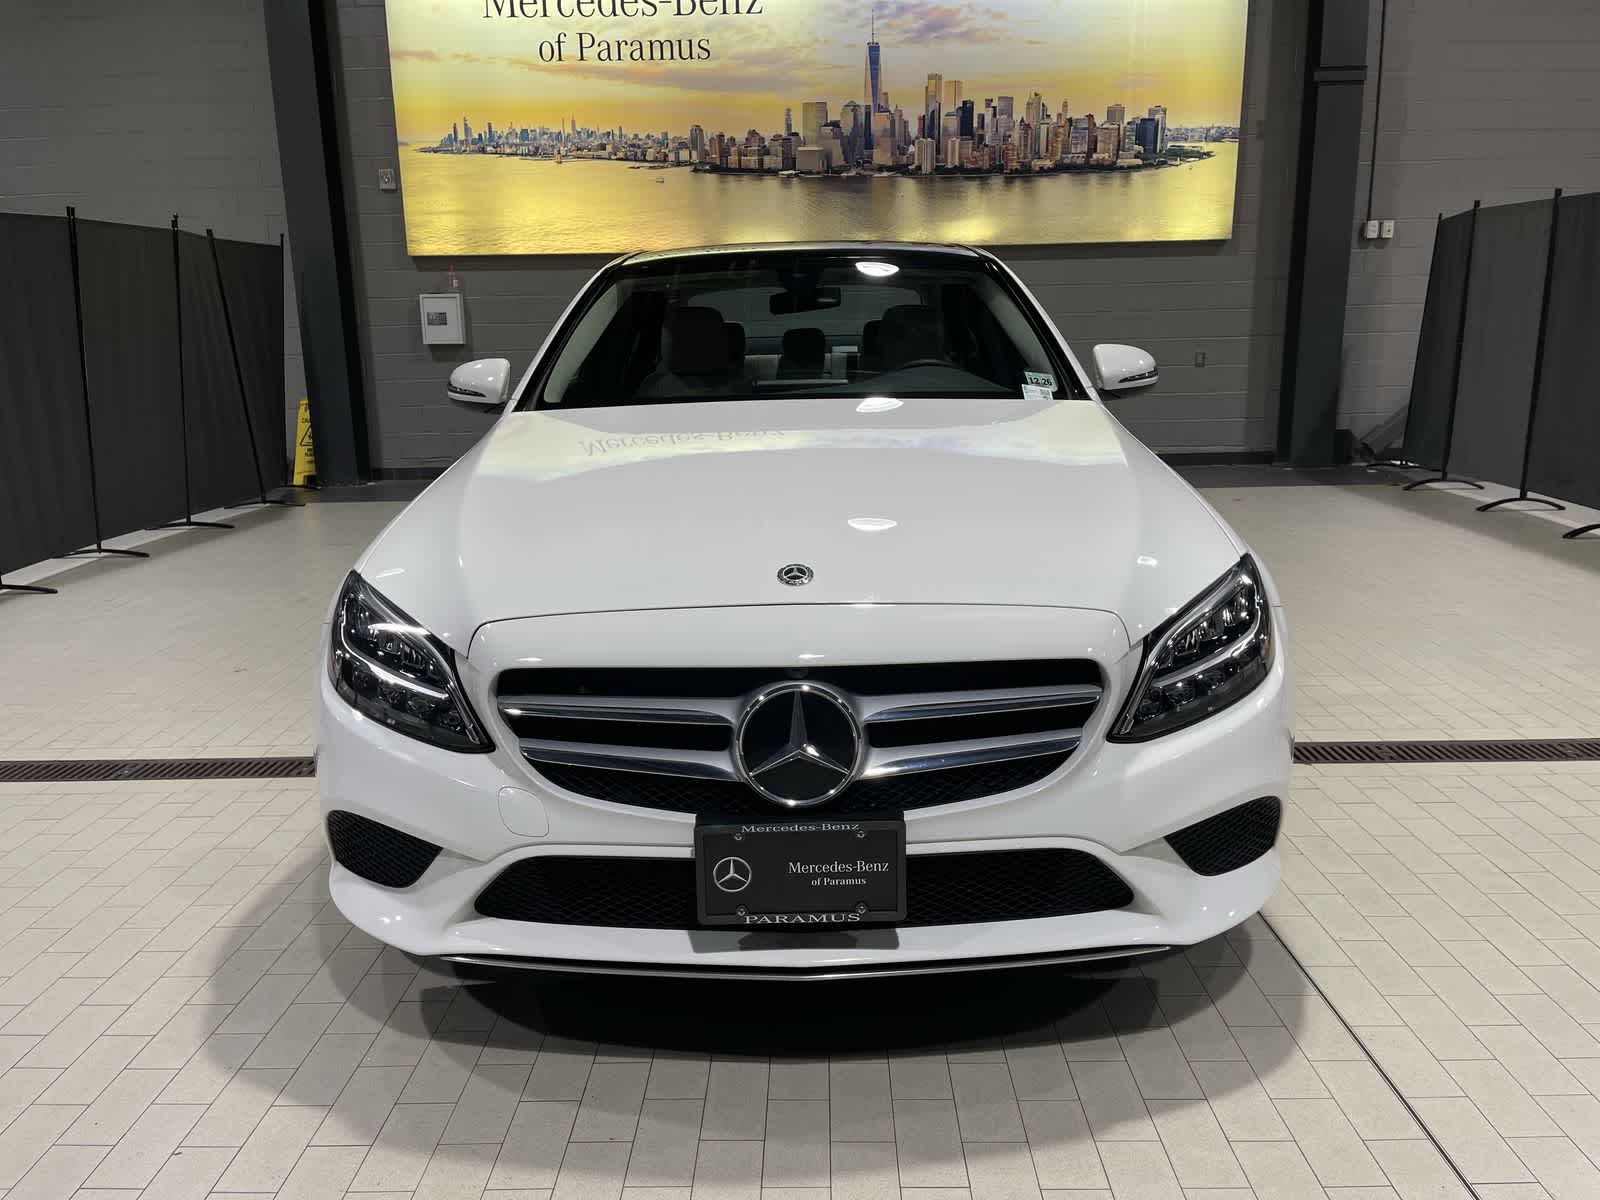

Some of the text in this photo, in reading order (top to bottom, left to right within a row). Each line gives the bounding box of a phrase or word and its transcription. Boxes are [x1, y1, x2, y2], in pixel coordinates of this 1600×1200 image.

[538, 31, 711, 62] of Paramus
[741, 823, 860, 833] Mercedes-Benz
[788, 860, 889, 874] Mercedes-Benz
[811, 877, 867, 886] of Paramus
[743, 913, 861, 924] PARAMUS
